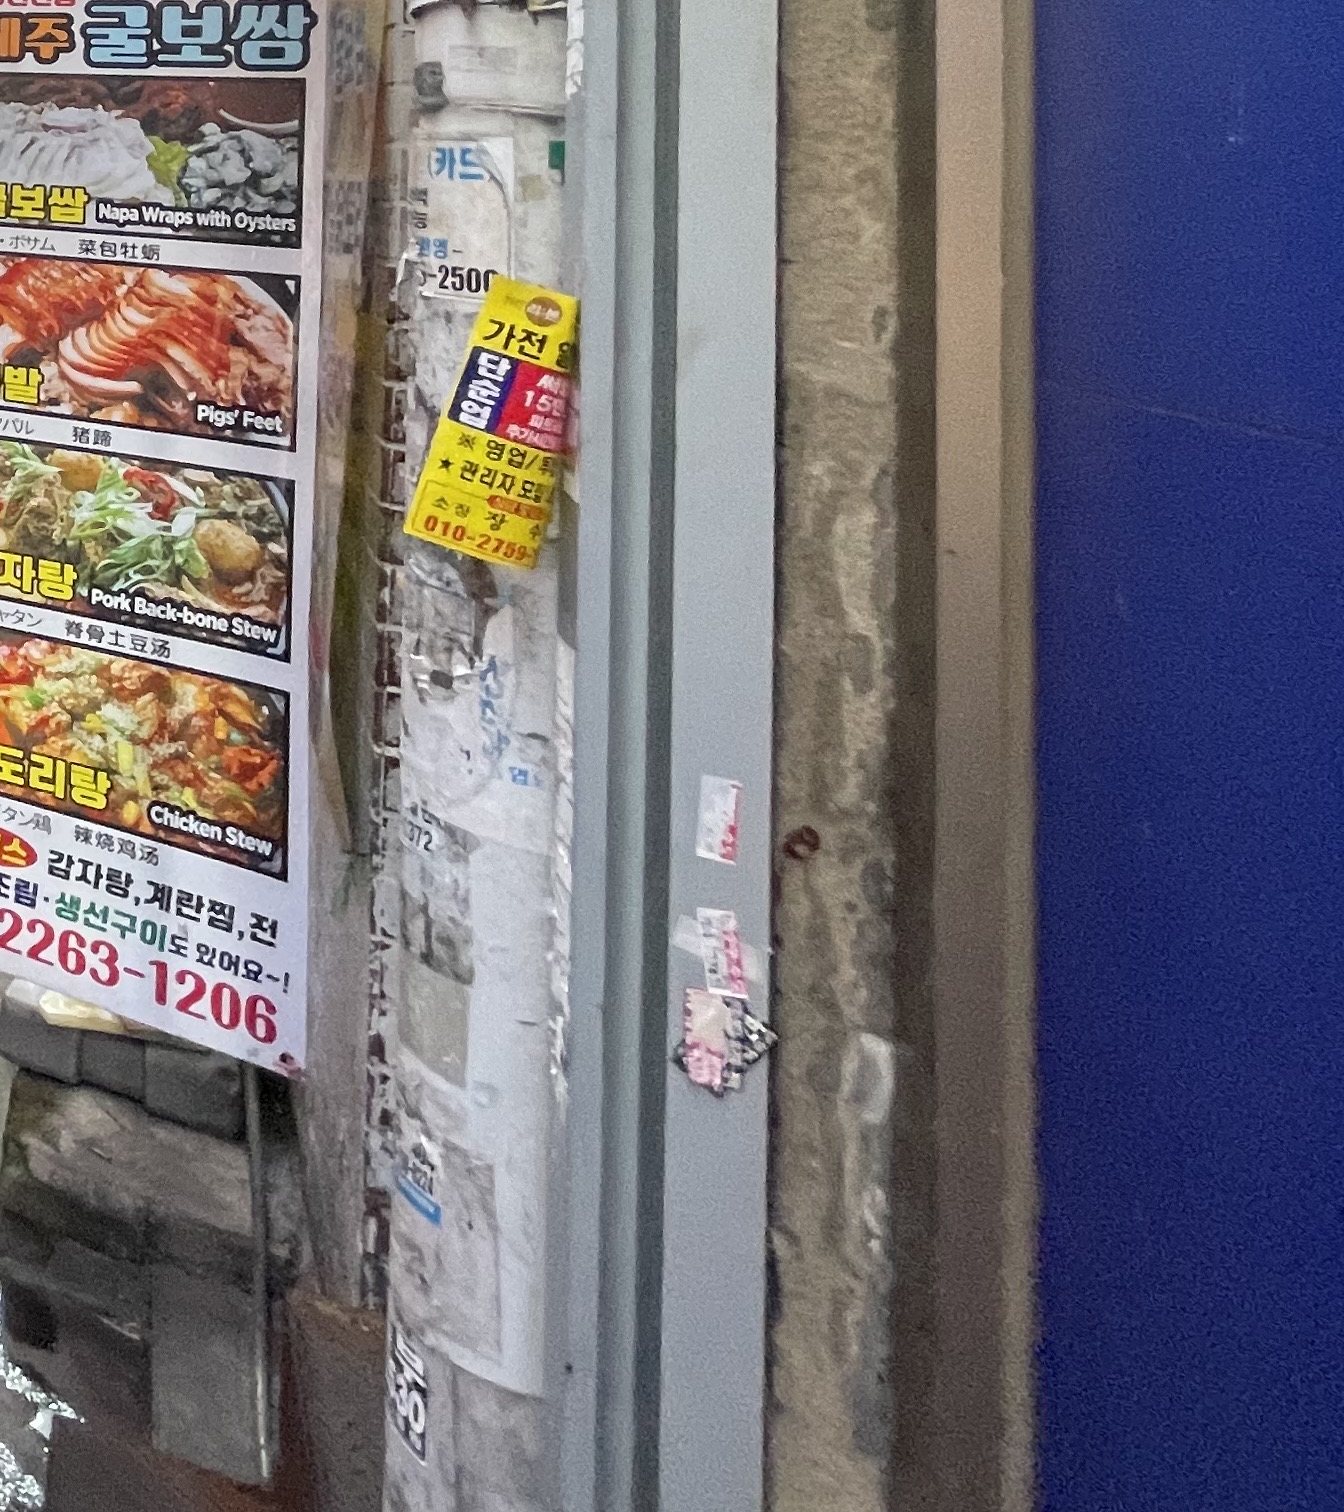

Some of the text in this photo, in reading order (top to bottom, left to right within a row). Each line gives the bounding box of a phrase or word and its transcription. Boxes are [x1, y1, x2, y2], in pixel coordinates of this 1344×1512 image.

[82, 0, 318, 72] 굴보쌈
[98, 202, 297, 235] Napa Wraps with Oysters
[483, 319, 548, 360] 가전
[242, 408, 285, 434] Feet
[460, 460, 516, 496] 관리자
[90, 588, 278, 645] Pork Back-bone Stew
[148, 803, 274, 859] Chicken Stew
